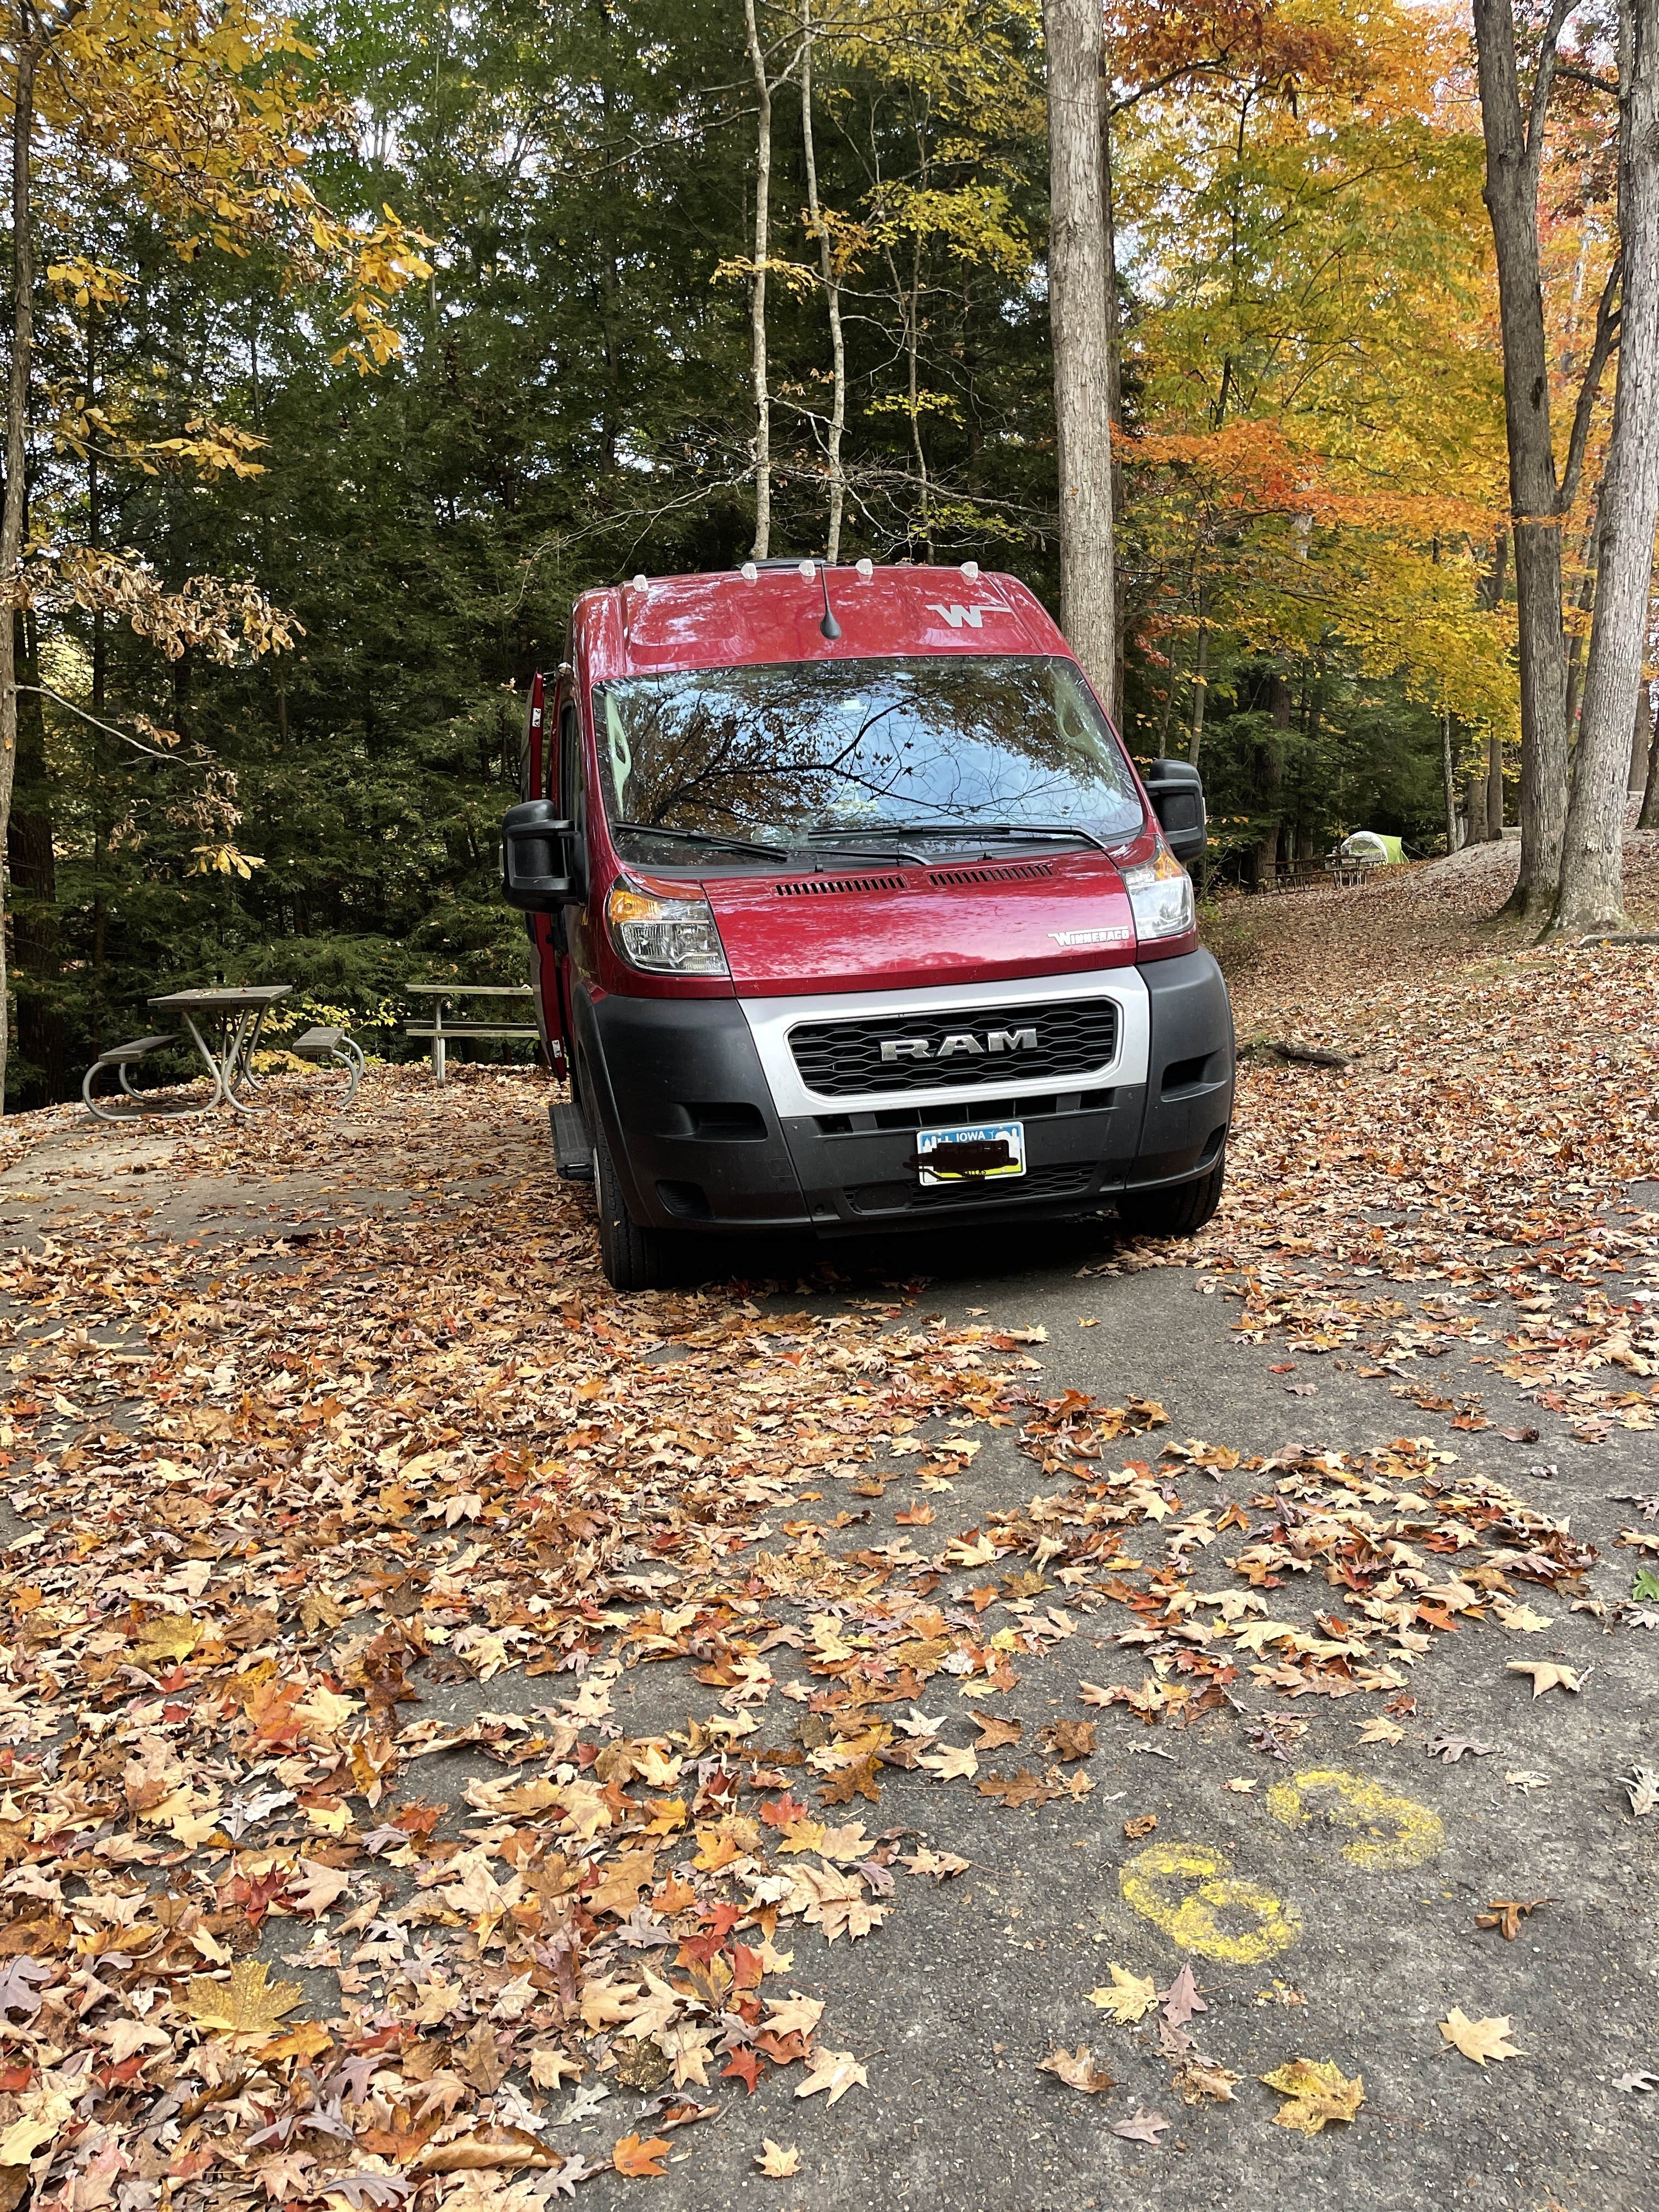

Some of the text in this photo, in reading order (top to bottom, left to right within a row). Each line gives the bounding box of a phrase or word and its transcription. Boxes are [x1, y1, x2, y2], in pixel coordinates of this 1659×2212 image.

[1048, 926, 1129, 946] WINNEBAGO
[881, 1028, 1037, 1061] RAM
[956, 1131, 986, 1142] IOWA
